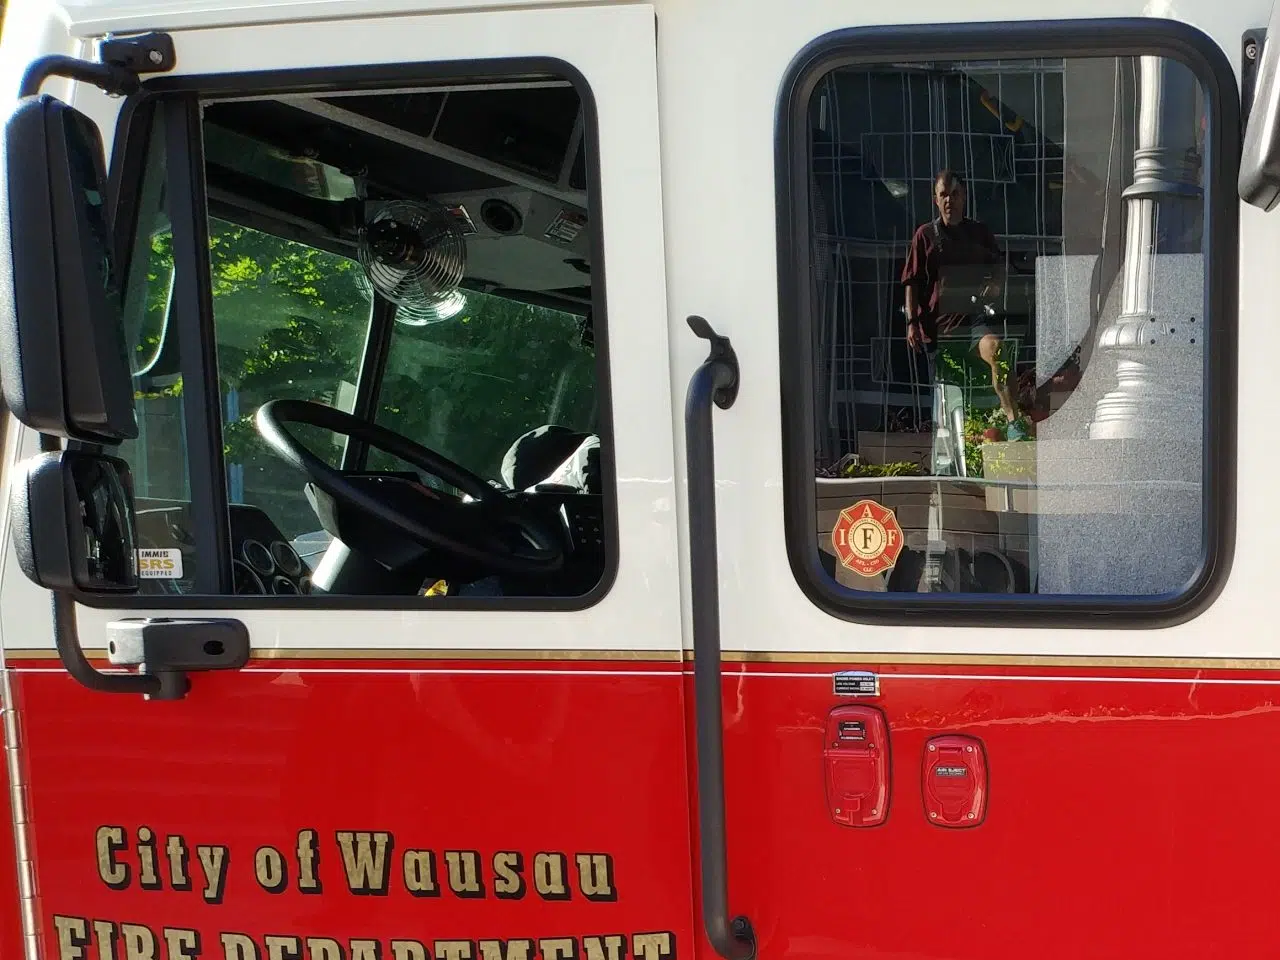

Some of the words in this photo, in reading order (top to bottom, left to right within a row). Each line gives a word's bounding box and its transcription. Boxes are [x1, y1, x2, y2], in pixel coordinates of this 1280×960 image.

[861, 504, 873, 518] A
[861, 527, 875, 550] F
[886, 529, 898, 546] F
[95, 825, 230, 905] City
[254, 829, 322, 896] of
[336, 830, 618, 903] Wausau
